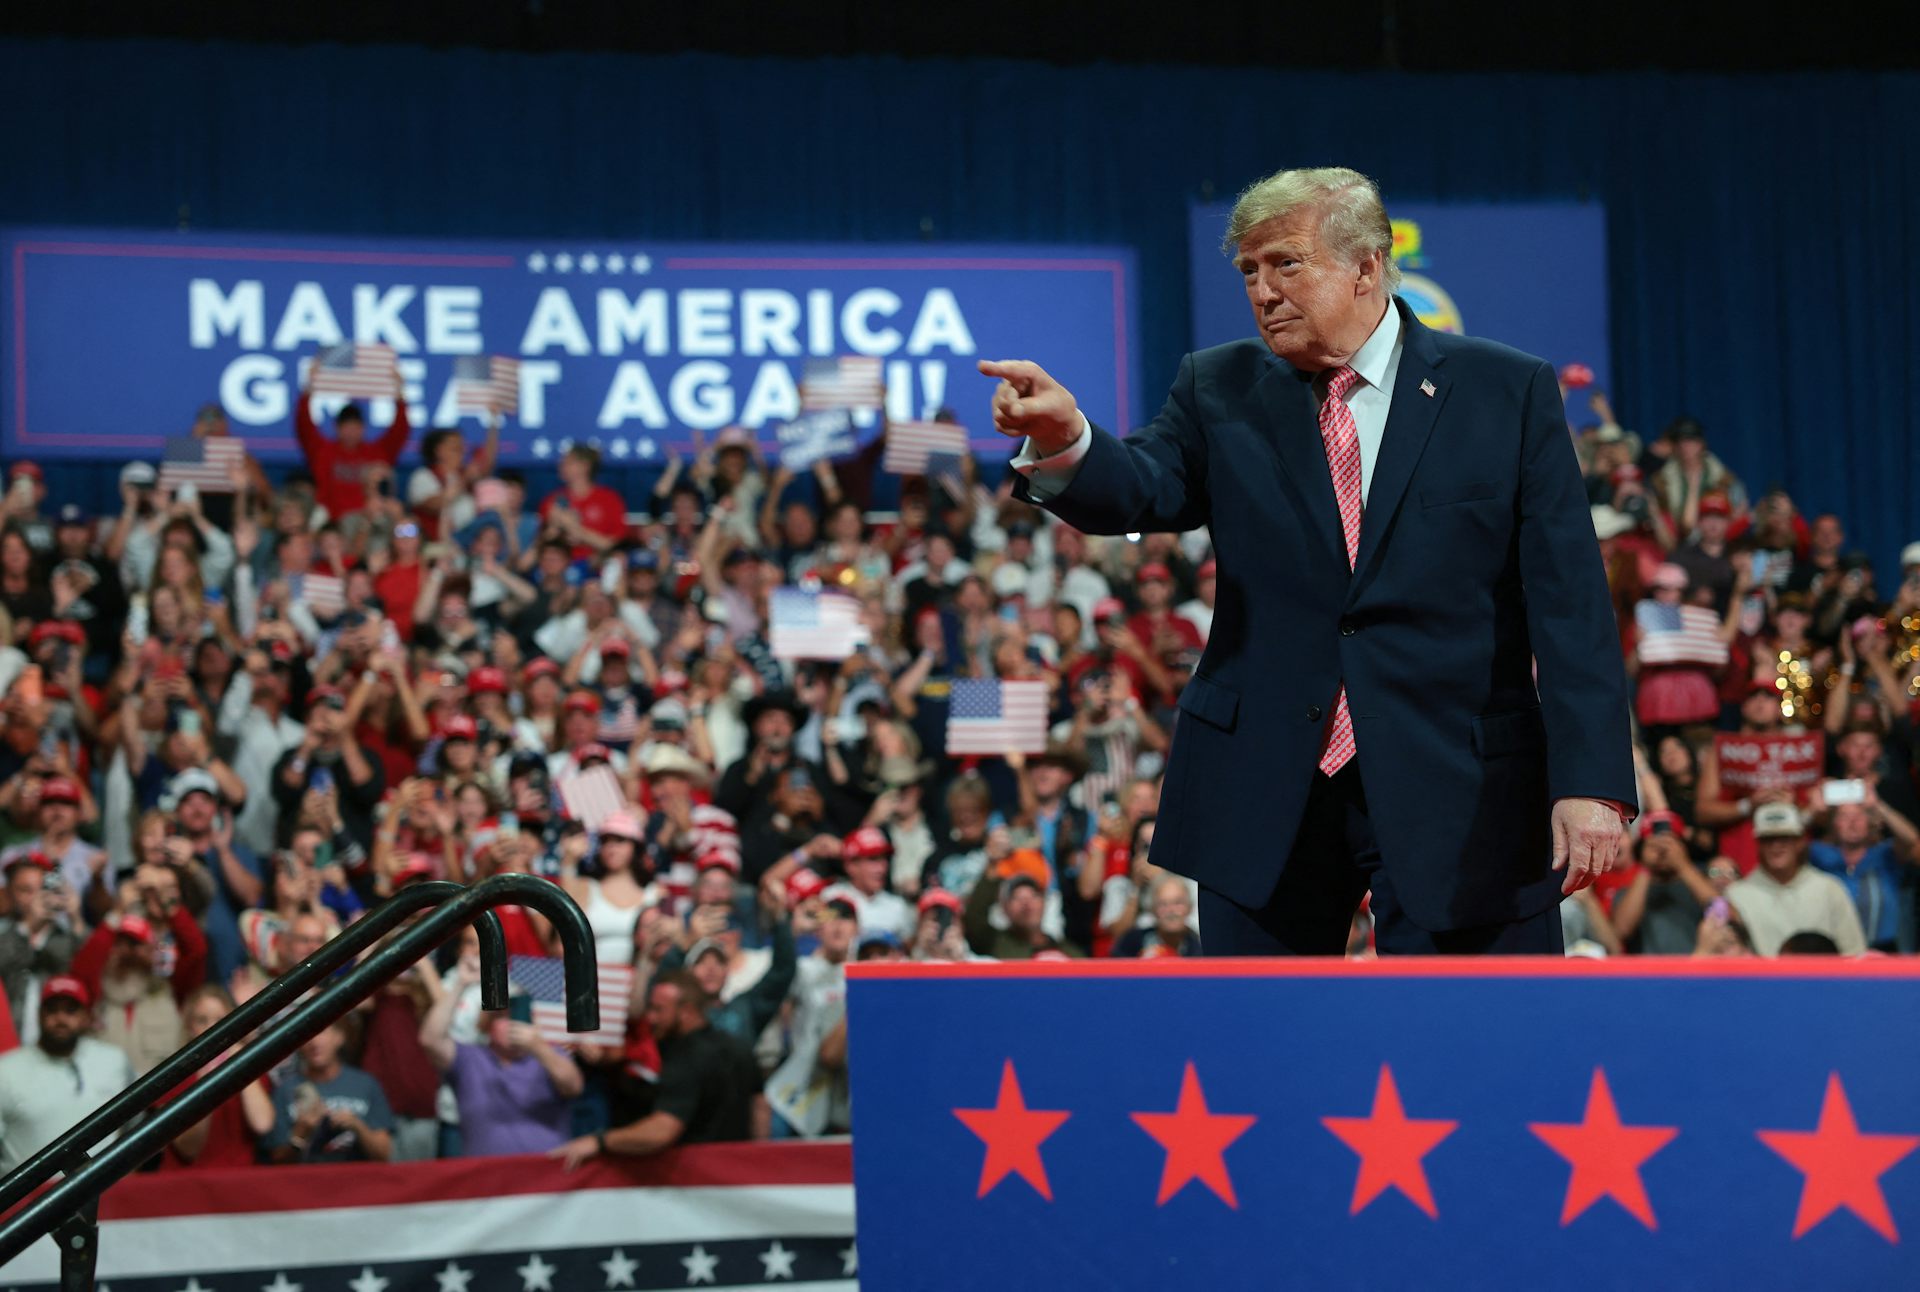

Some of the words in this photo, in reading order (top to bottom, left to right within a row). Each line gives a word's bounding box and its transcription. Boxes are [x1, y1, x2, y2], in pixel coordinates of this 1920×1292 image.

[189, 278, 483, 354] MAKE
[519, 287, 977, 356] AMERICA
[596, 358, 947, 429] AGA!
[1721, 742, 1761, 763] NO
[1765, 740, 1816, 762] TAX
